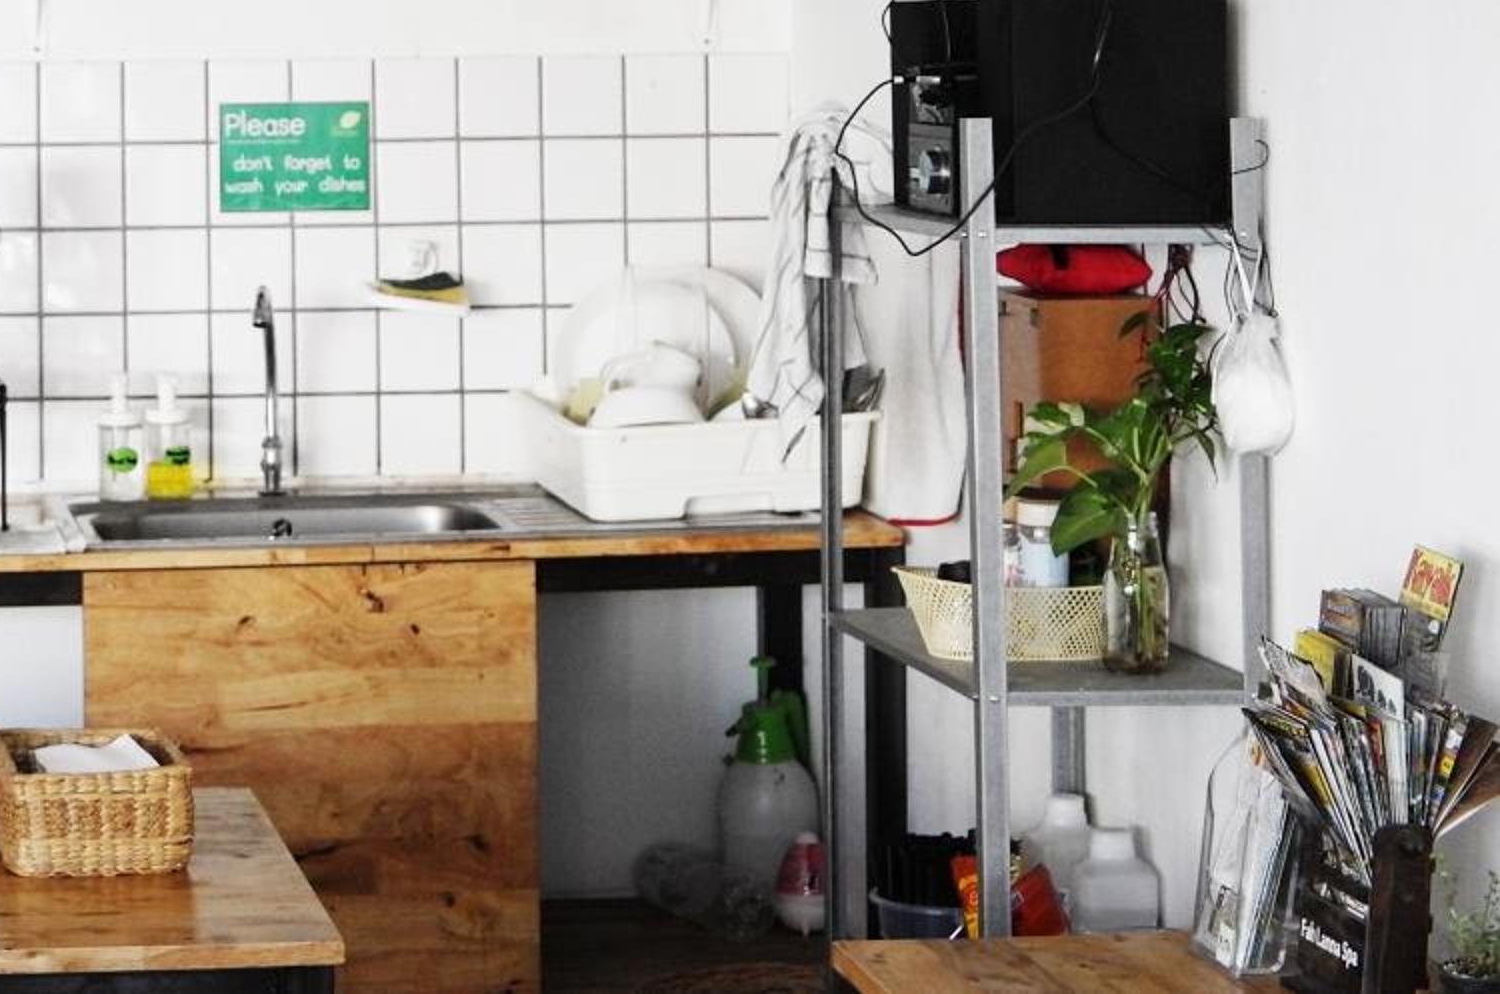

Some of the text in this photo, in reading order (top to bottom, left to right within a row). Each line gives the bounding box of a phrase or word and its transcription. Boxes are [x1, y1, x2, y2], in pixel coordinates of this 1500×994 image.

[225, 110, 306, 138] Please
[283, 154, 332, 174] forget
[343, 153, 361, 170] to
[225, 176, 365, 197] wash your dishes
